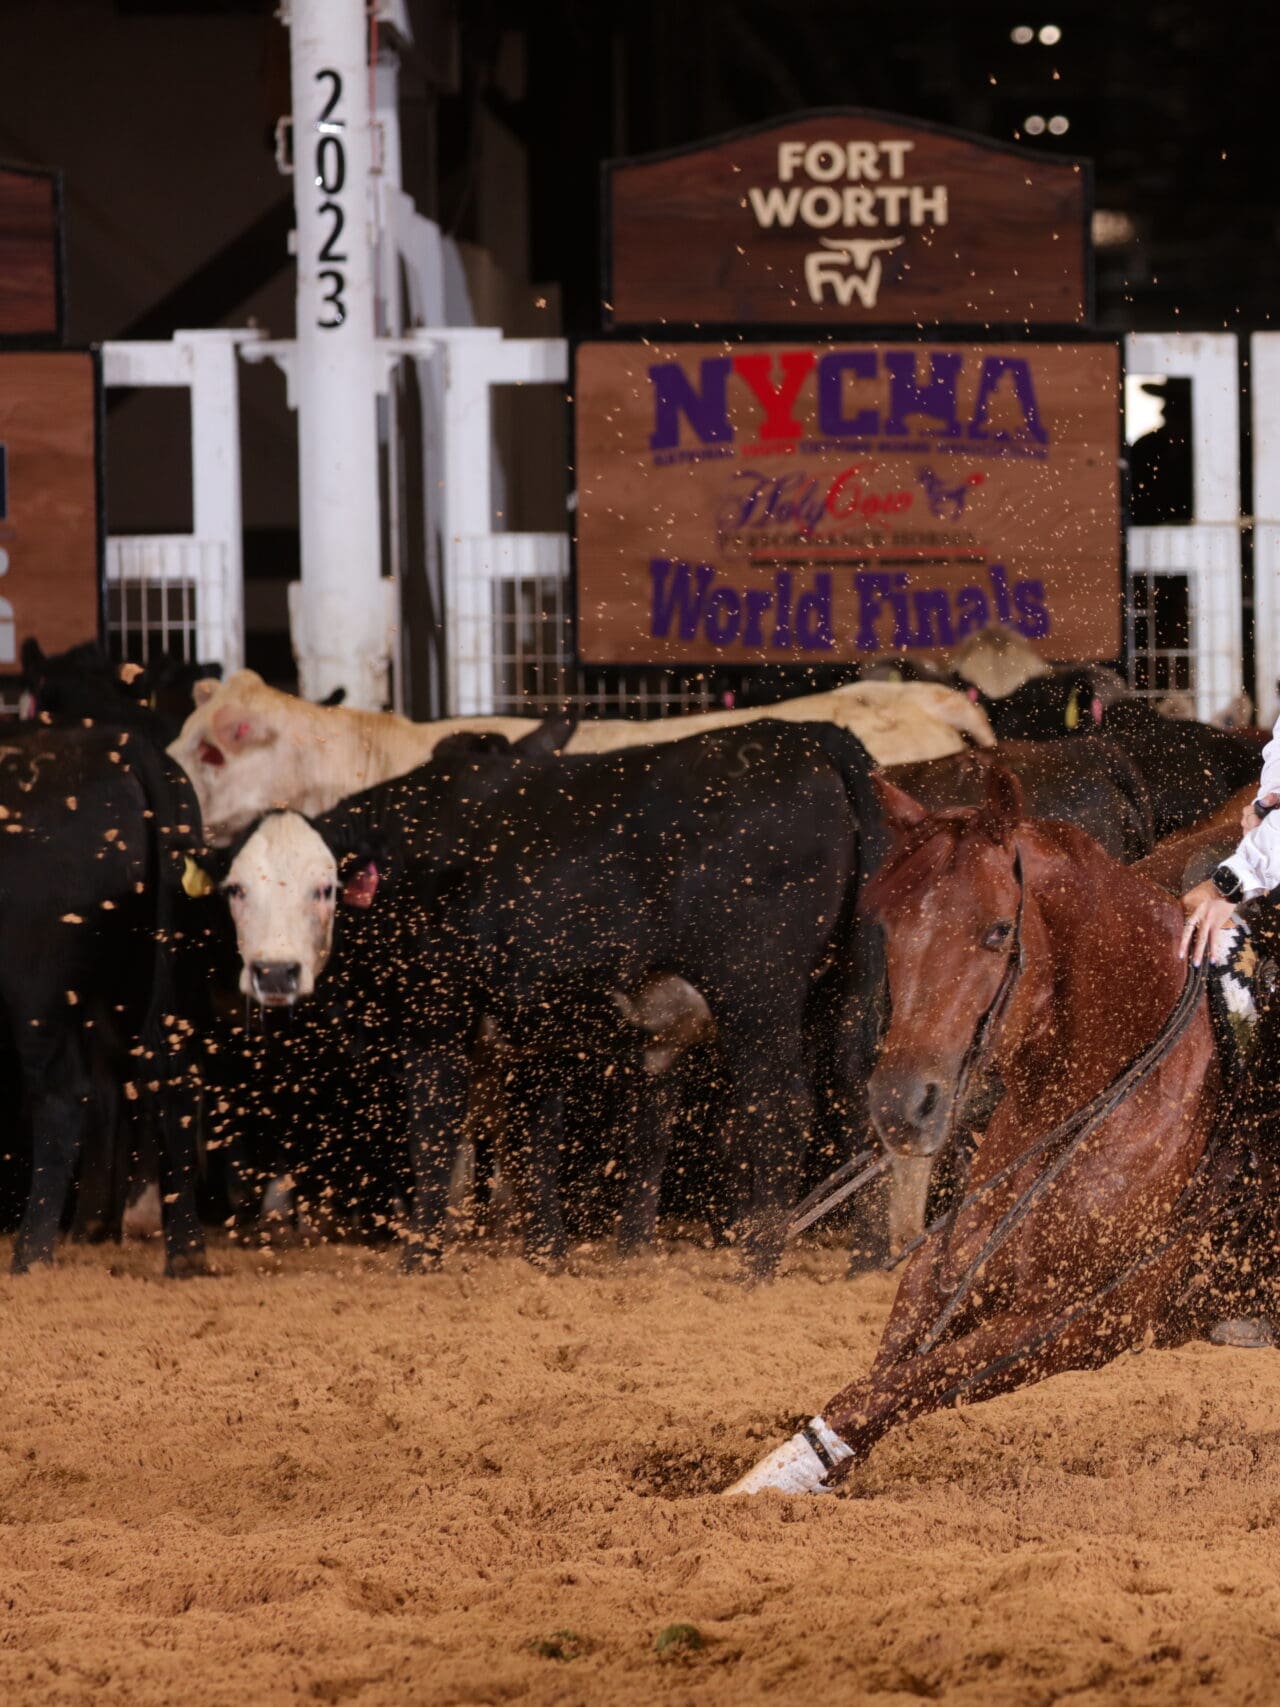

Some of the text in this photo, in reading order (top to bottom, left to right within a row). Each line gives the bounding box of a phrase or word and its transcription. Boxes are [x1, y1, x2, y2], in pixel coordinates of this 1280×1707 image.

[315, 70, 347, 328] 2023
[749, 185, 949, 228] WORTH
[779, 140, 914, 182] FORT
[649, 350, 1049, 451] NYCHA
[649, 557, 1051, 652] World Finals
